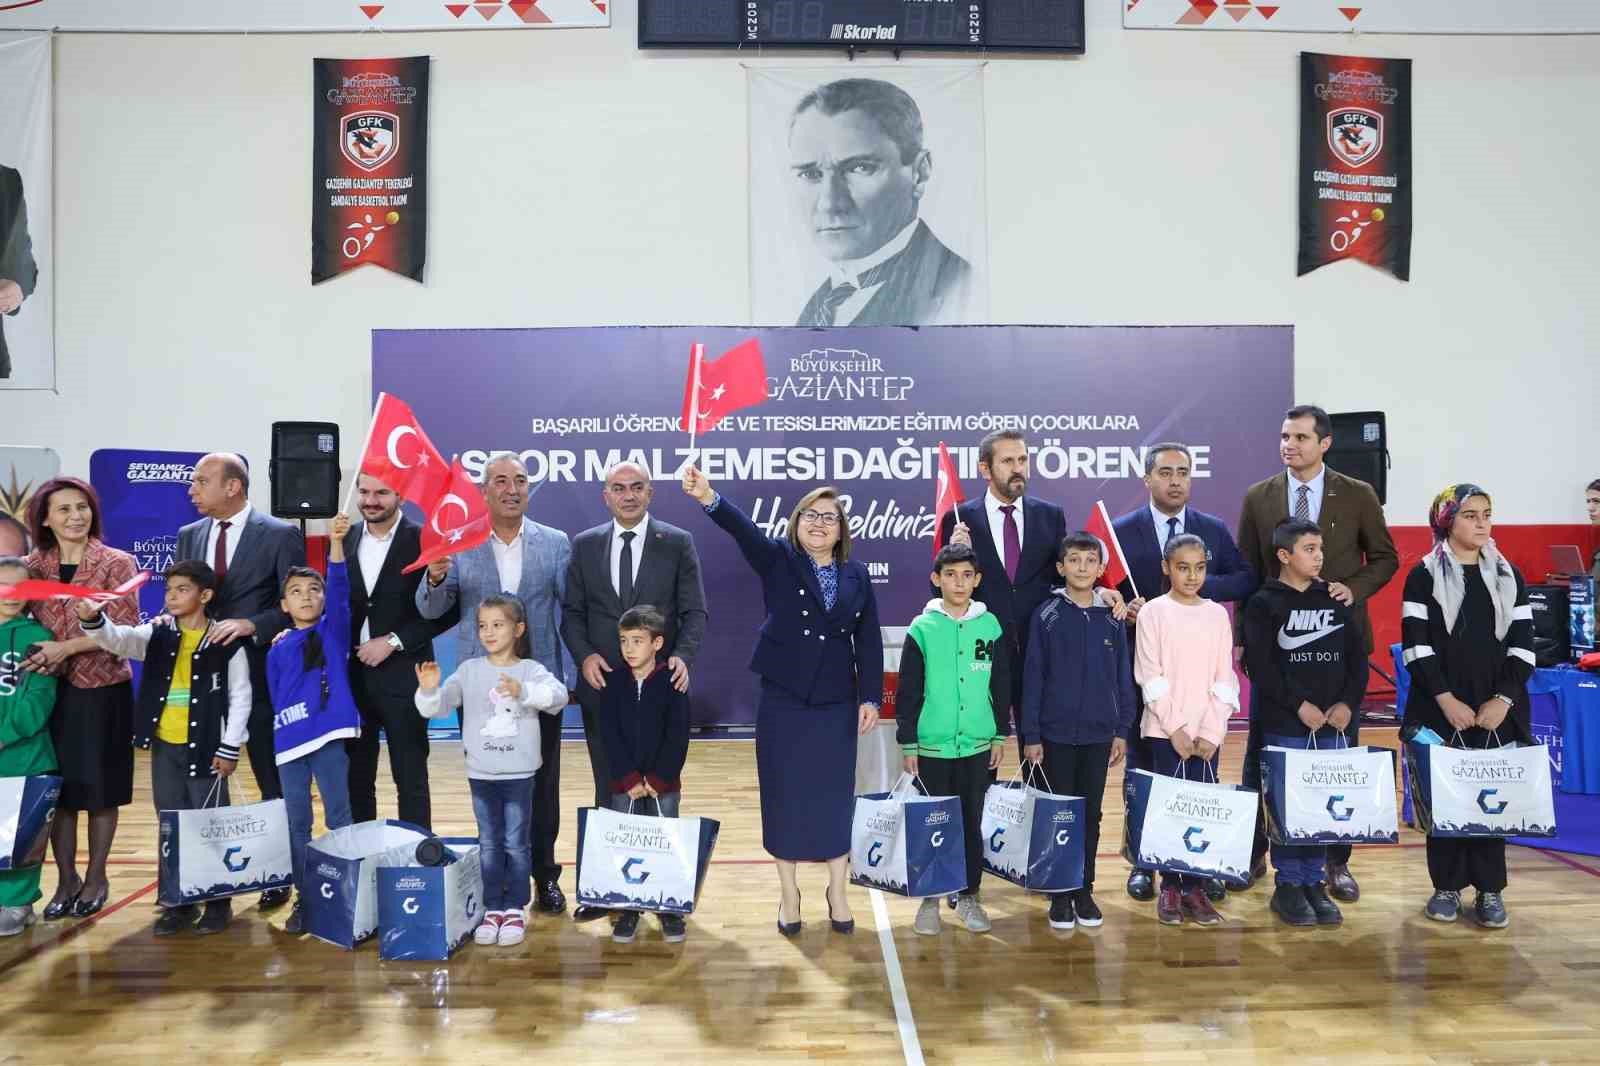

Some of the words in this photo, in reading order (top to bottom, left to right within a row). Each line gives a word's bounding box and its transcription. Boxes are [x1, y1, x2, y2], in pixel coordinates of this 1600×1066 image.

[969, 4, 980, 42] BONUS
[843, 24, 897, 40] Skorled
[358, 116, 384, 128] GFK
[1343, 113, 1368, 125] GFK
[790, 357, 884, 375] BÜYÜKŞEHİR
[532, 417, 609, 436] BAŞARILI
[737, 416, 760, 432] VE
[965, 411, 1027, 430] GÖREN
[1030, 415, 1140, 433] ÇOCUKLARA
[127, 470, 192, 480] GAZİANT
[751, 496, 789, 540] Ho
[1286, 609, 1335, 631] NIKE
[1289, 651, 1313, 662] JUST
[1316, 651, 1331, 662] DO
